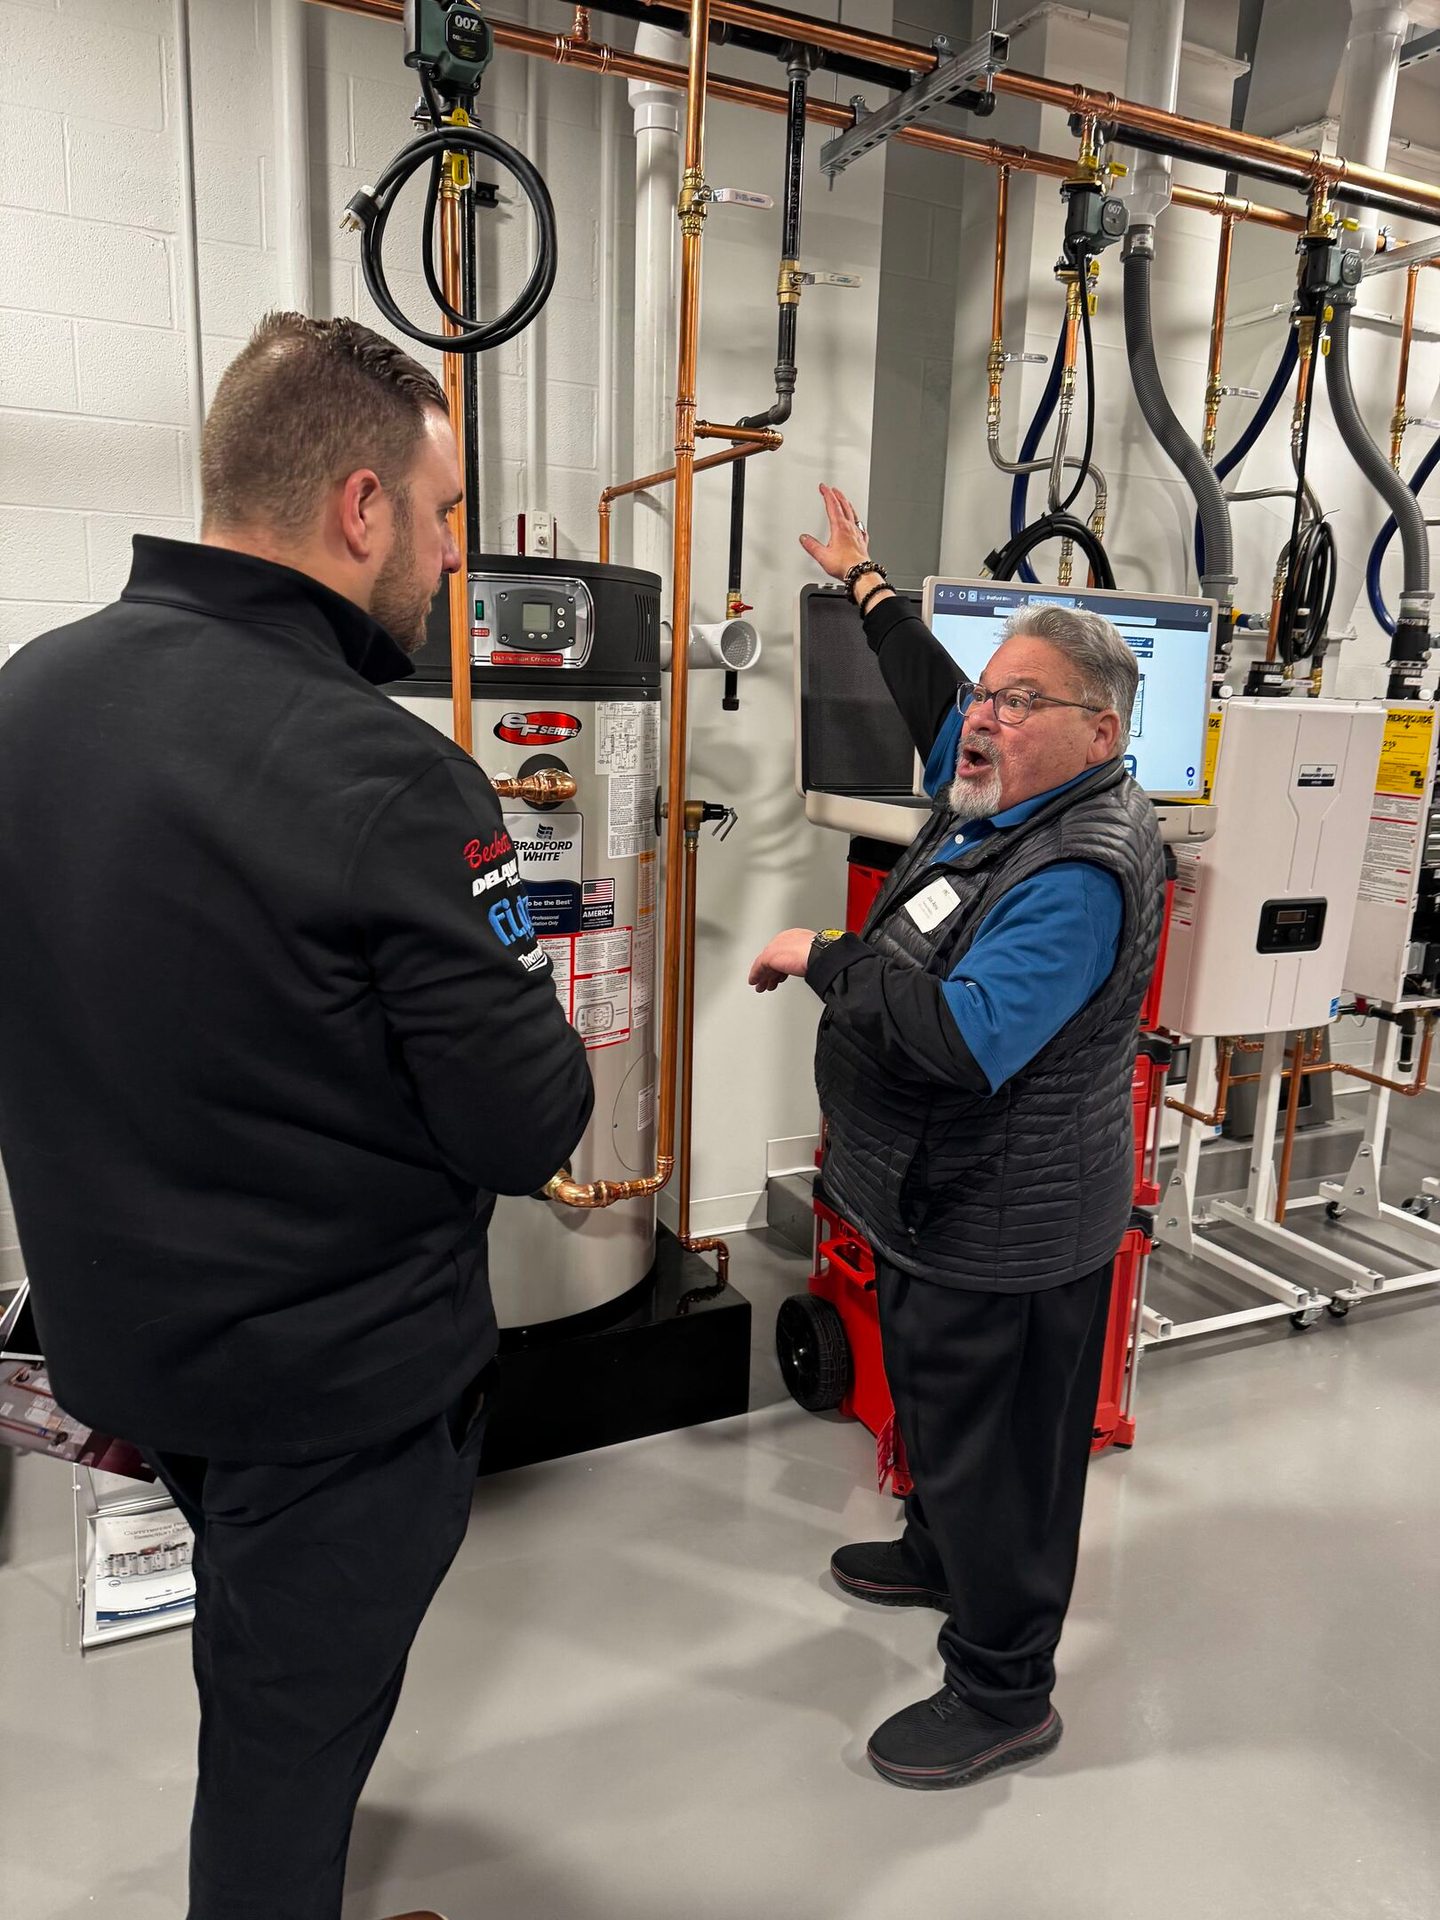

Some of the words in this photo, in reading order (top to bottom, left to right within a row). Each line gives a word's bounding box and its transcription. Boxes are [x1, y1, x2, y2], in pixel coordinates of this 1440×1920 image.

[539, 726, 578, 738] SERIES
[513, 840, 573, 851] BRADFORD
[522, 851, 561, 862] WHITE
[543, 898, 555, 906] the
[582, 908, 614, 918] AMERICA
